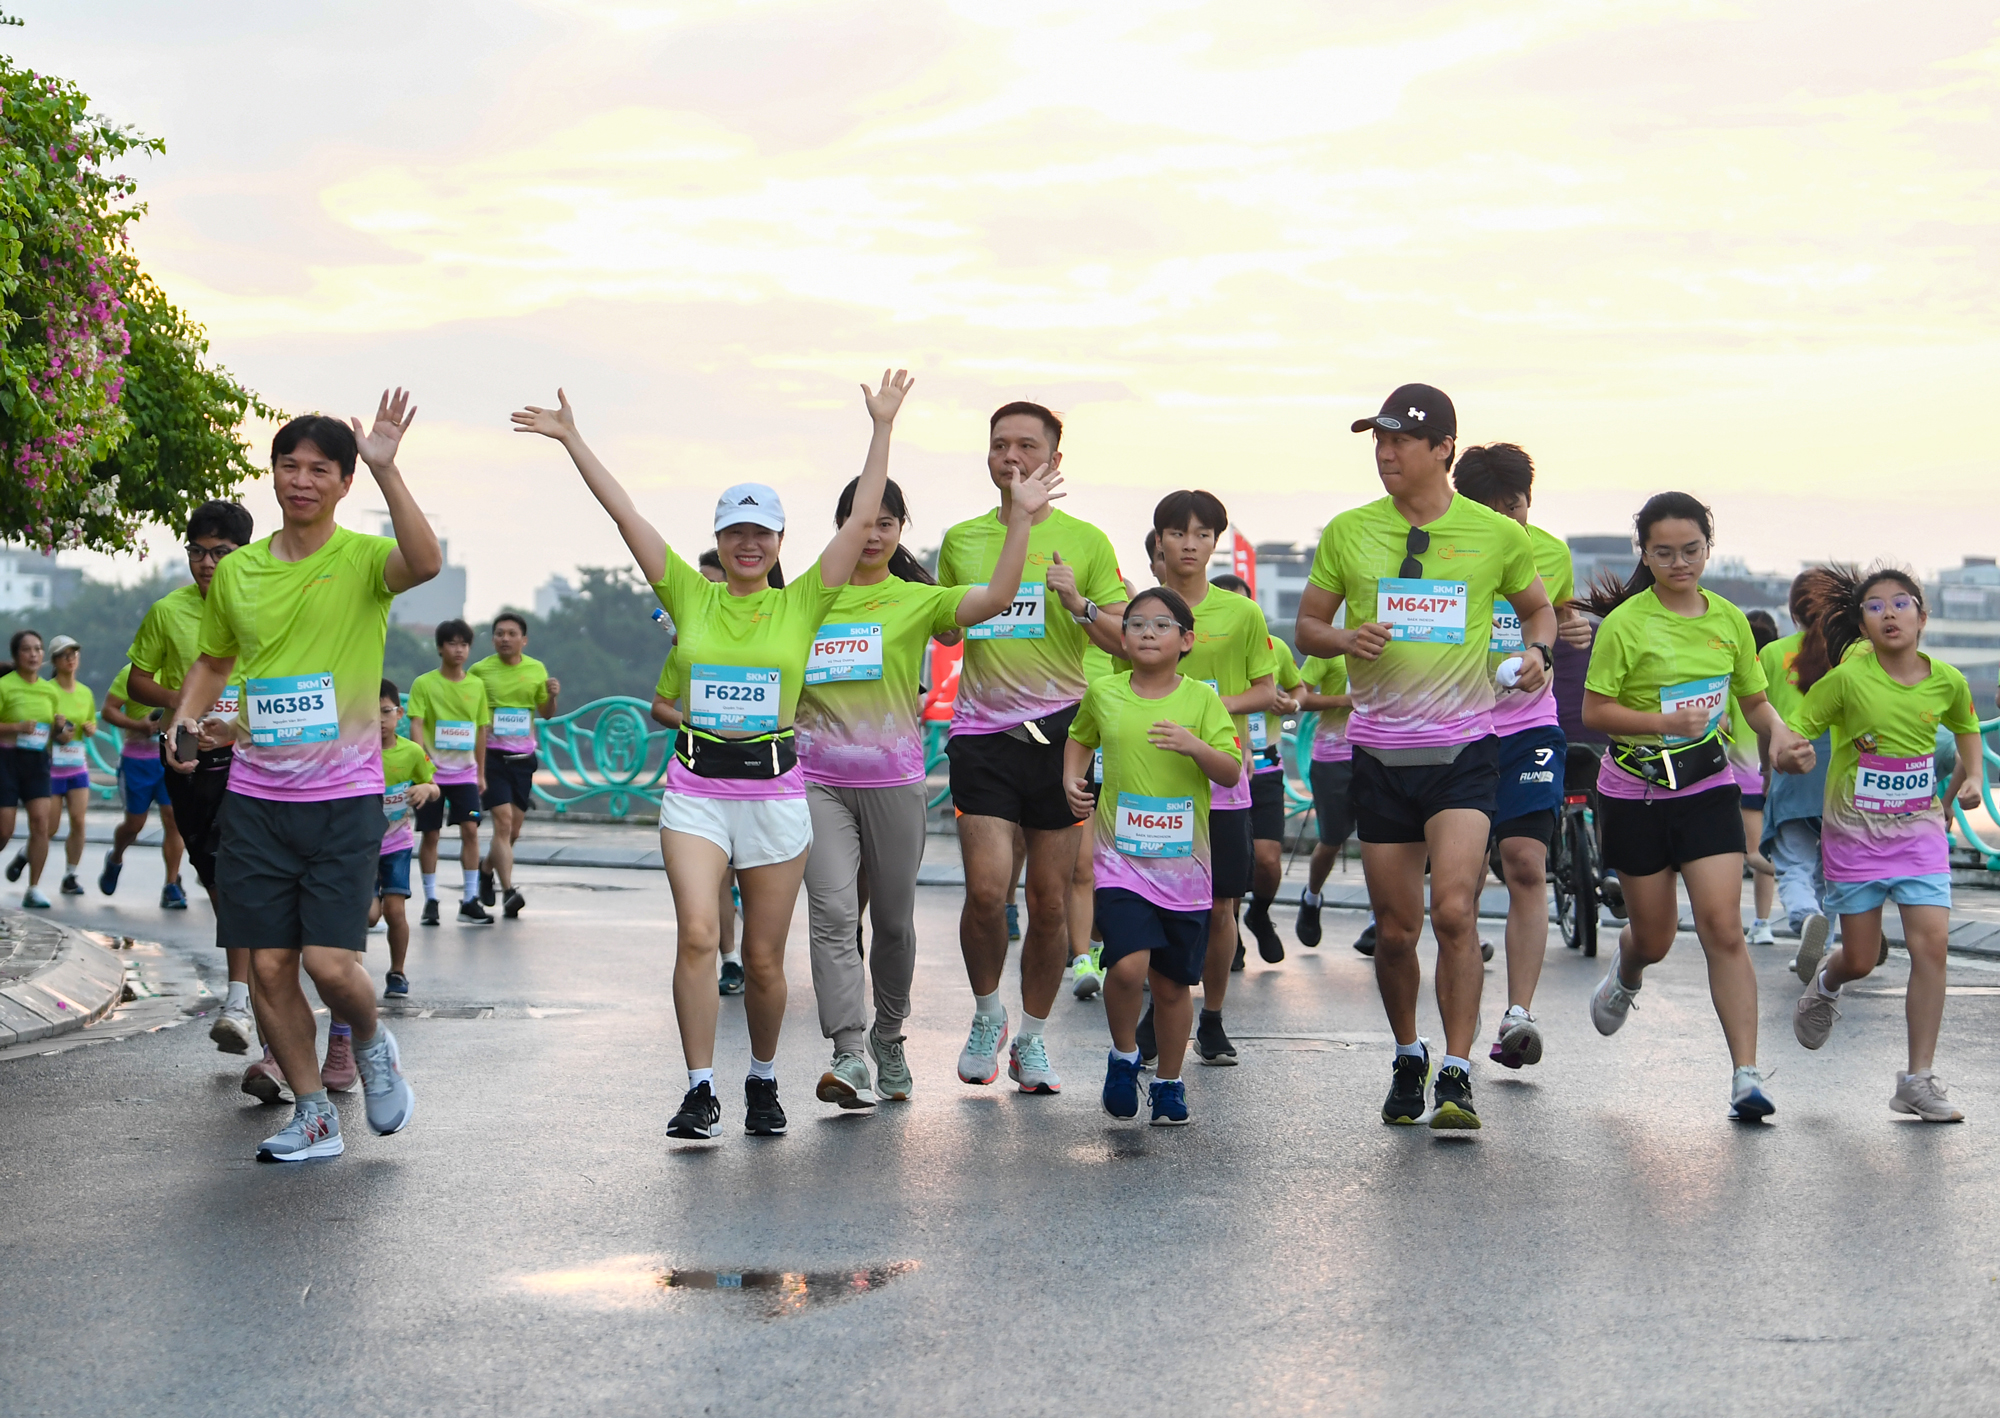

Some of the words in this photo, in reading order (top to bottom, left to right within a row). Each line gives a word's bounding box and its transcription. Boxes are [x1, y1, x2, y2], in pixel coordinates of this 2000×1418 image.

[814, 639, 868, 656] F6770
[297, 680, 319, 690] 5KM
[746, 673, 767, 681] 5KM
[705, 685, 765, 701] F6228
[257, 694, 324, 715] M6383
[441, 729, 470, 737] M5665
[1863, 772, 1929, 790] F8808
[1127, 811, 1183, 829] M6415
